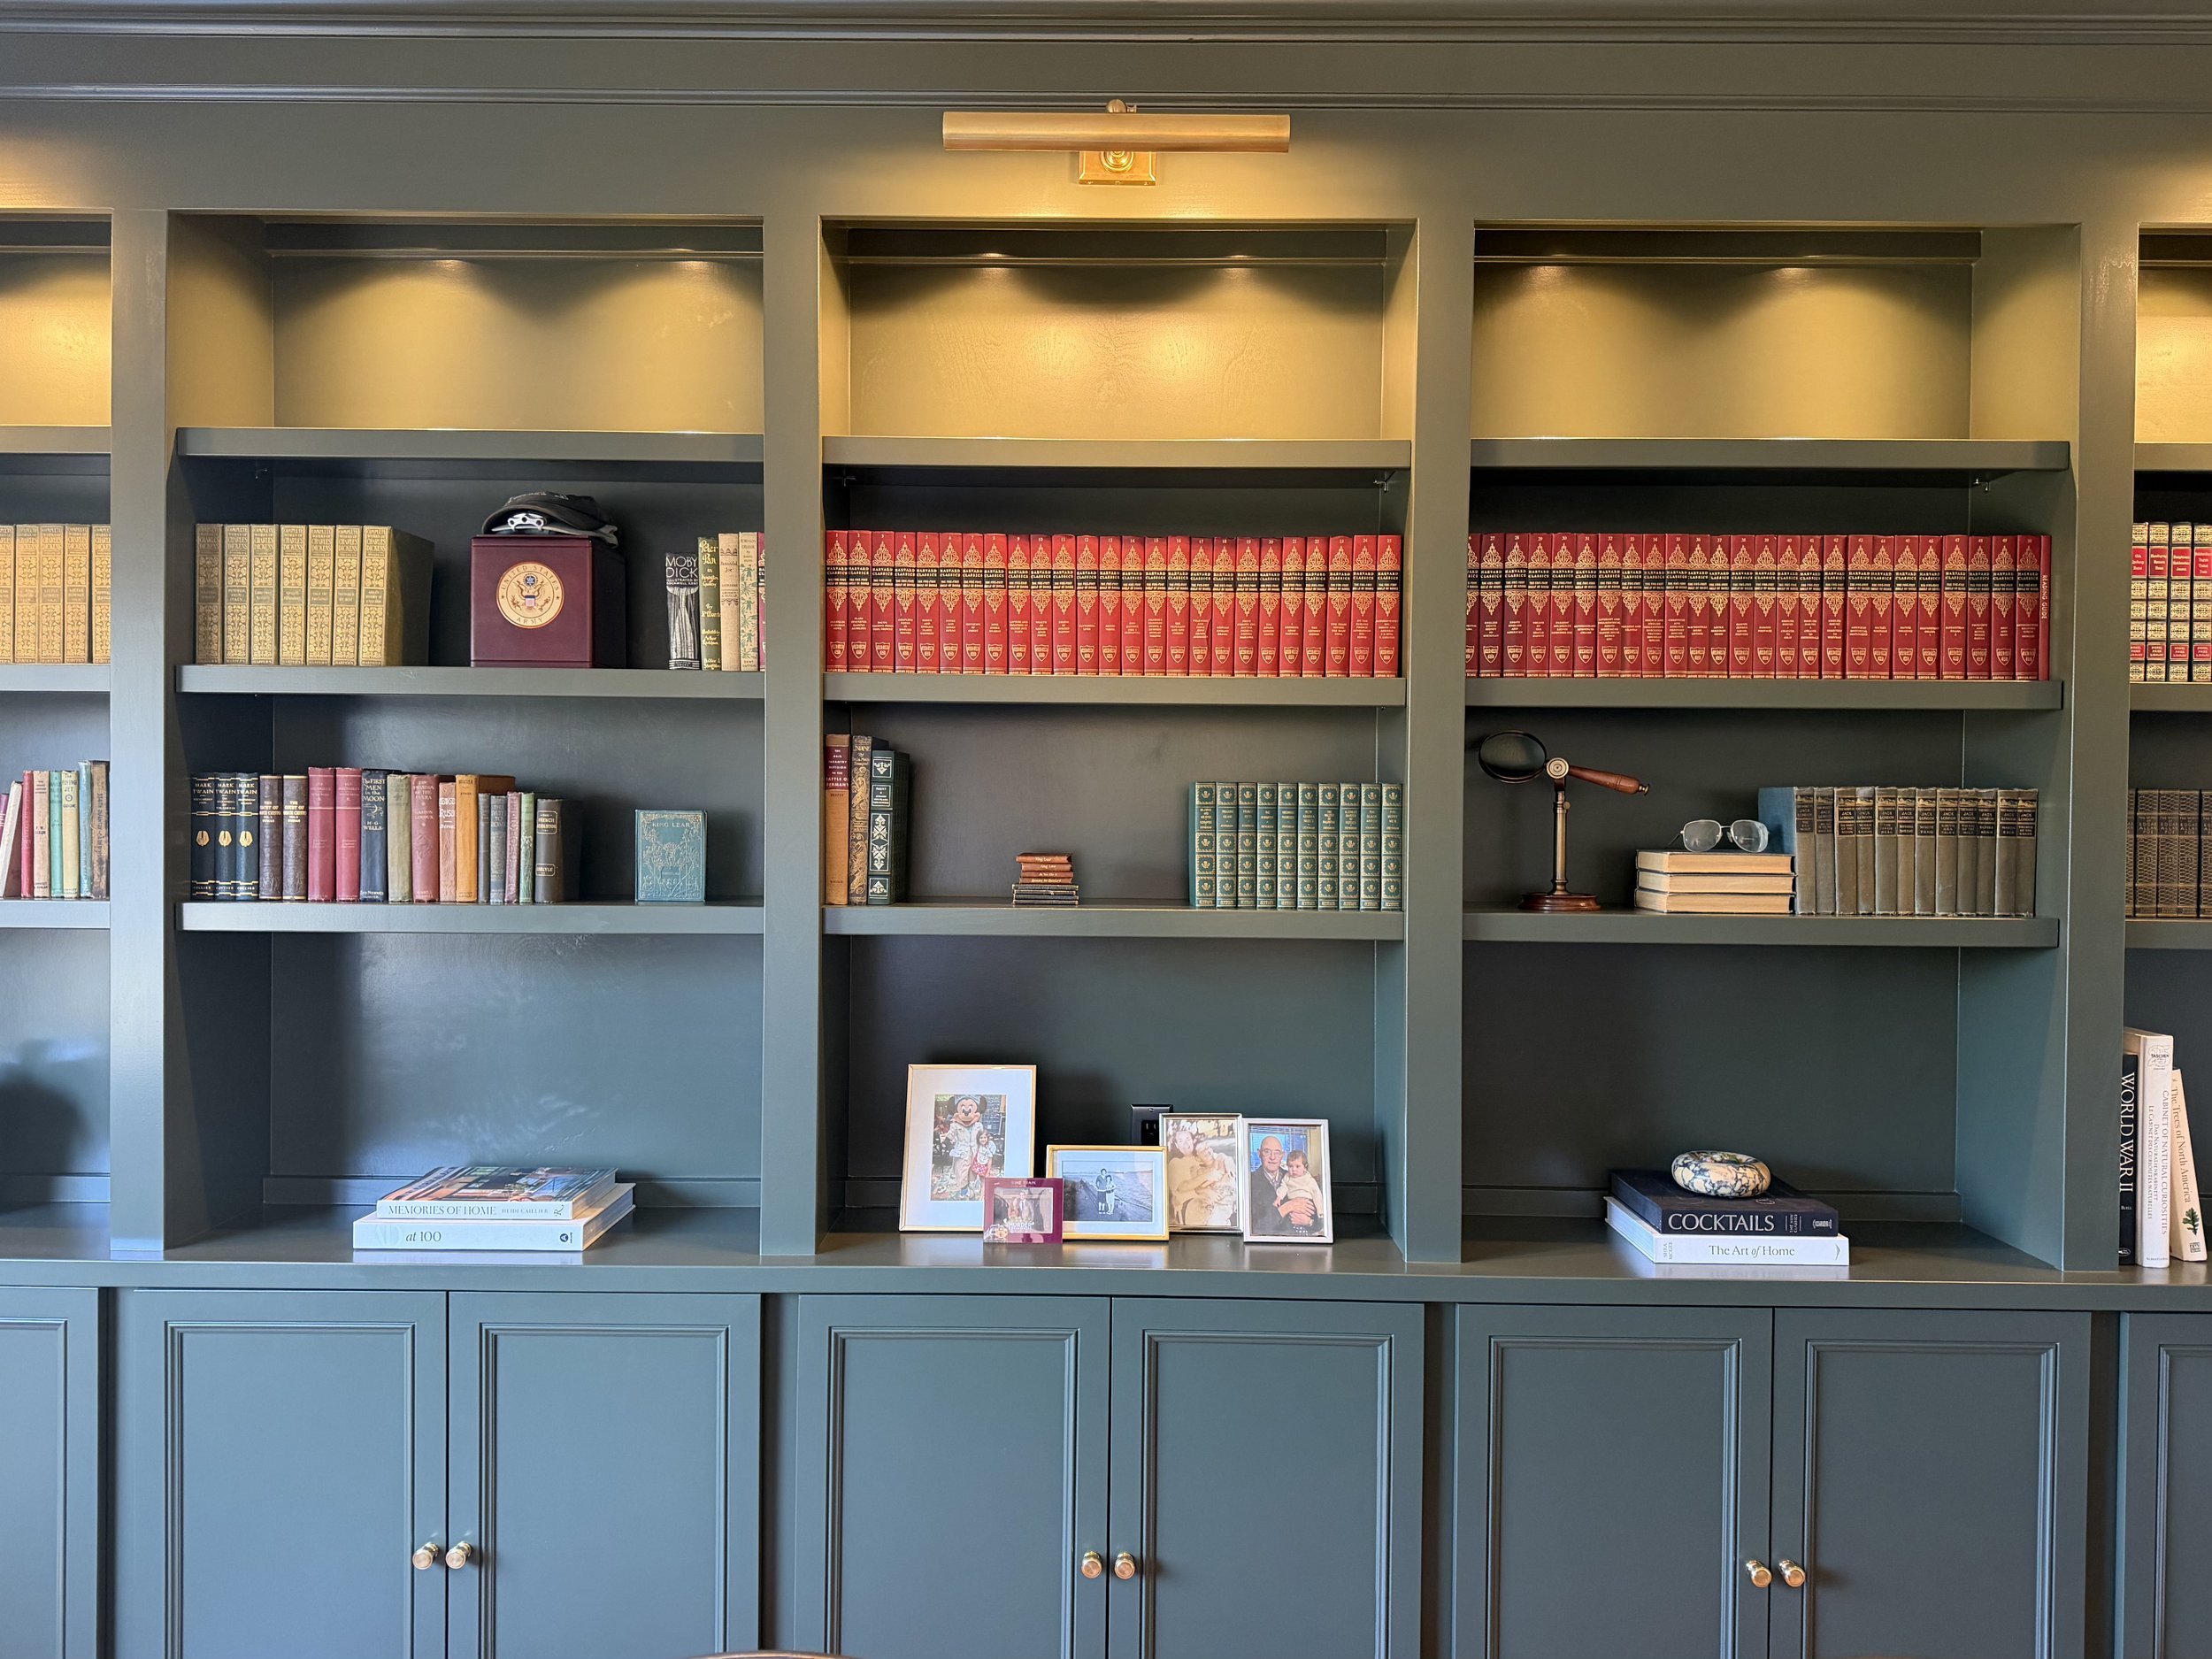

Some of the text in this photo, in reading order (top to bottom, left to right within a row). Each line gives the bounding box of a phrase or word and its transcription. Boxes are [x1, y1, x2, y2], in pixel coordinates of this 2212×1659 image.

[700, 540, 718, 553] Peter
[665, 556, 698, 567] MOBY
[702, 553, 717, 565] Pan
[501, 565, 559, 591] UNITED STATES
[666, 567, 698, 578] DICK
[2172, 1105, 2182, 1129] Trees
[2119, 1072, 2135, 1192] WORLD WAR II
[2162, 1129, 2168, 1141] OF
[2176, 1130, 2185, 1140] of
[2177, 1141, 2188, 1166] North
[2181, 1168, 2193, 1203] America
[389, 1206, 444, 1215] MEMORIES
[446, 1206, 461, 1215] OF
[464, 1206, 496, 1215] HOME
[1668, 1213, 1775, 1232] COCKTAILS
[406, 1231, 416, 1242] at
[420, 1231, 442, 1242] 100
[1709, 1245, 1795, 1258] The Art of Home
